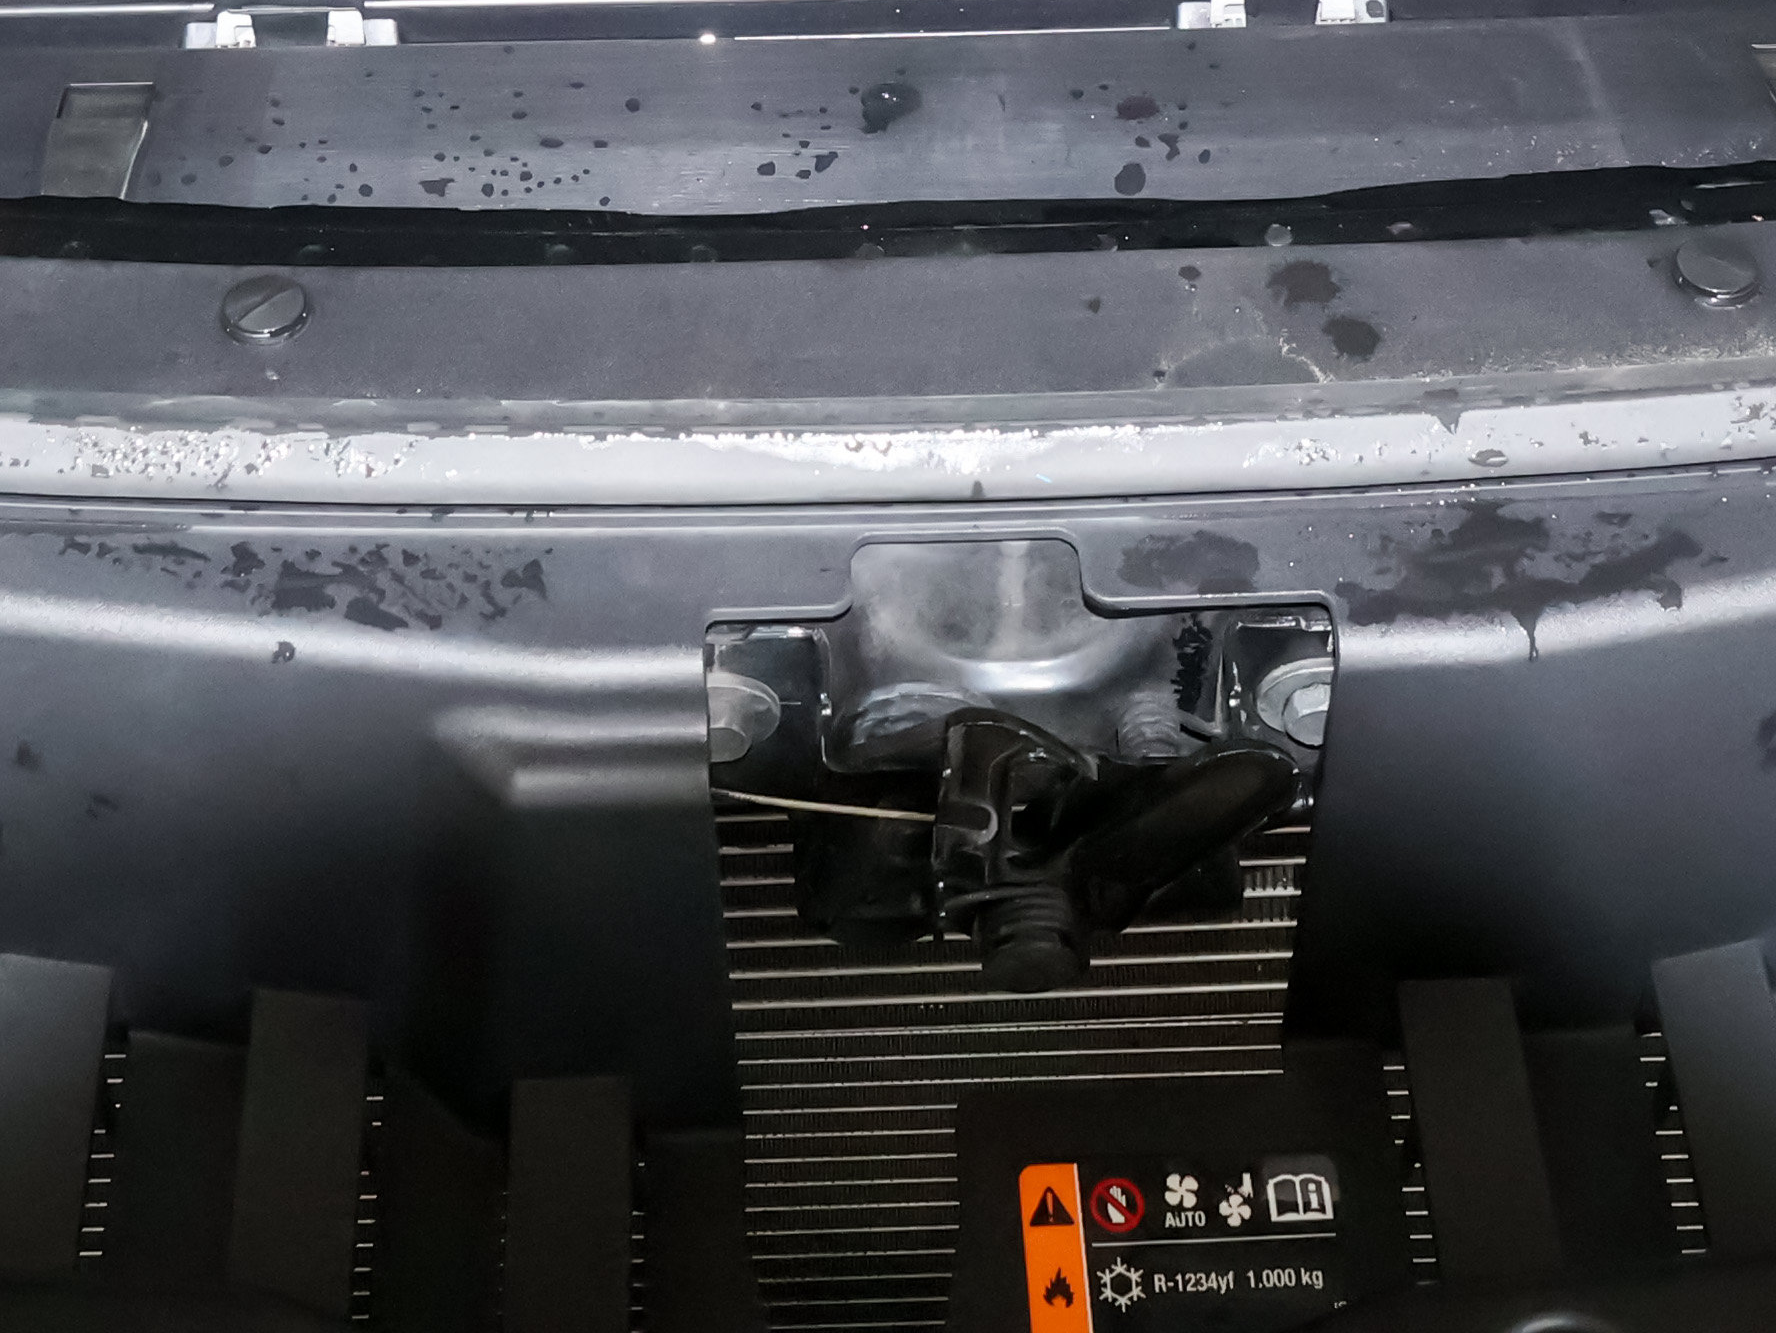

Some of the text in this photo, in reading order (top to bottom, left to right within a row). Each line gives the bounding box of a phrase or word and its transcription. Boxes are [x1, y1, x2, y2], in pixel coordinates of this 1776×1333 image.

[1164, 1210, 1207, 1229] AUTO
[1153, 1267, 1324, 1295] R-1234yf 1.000 kg
